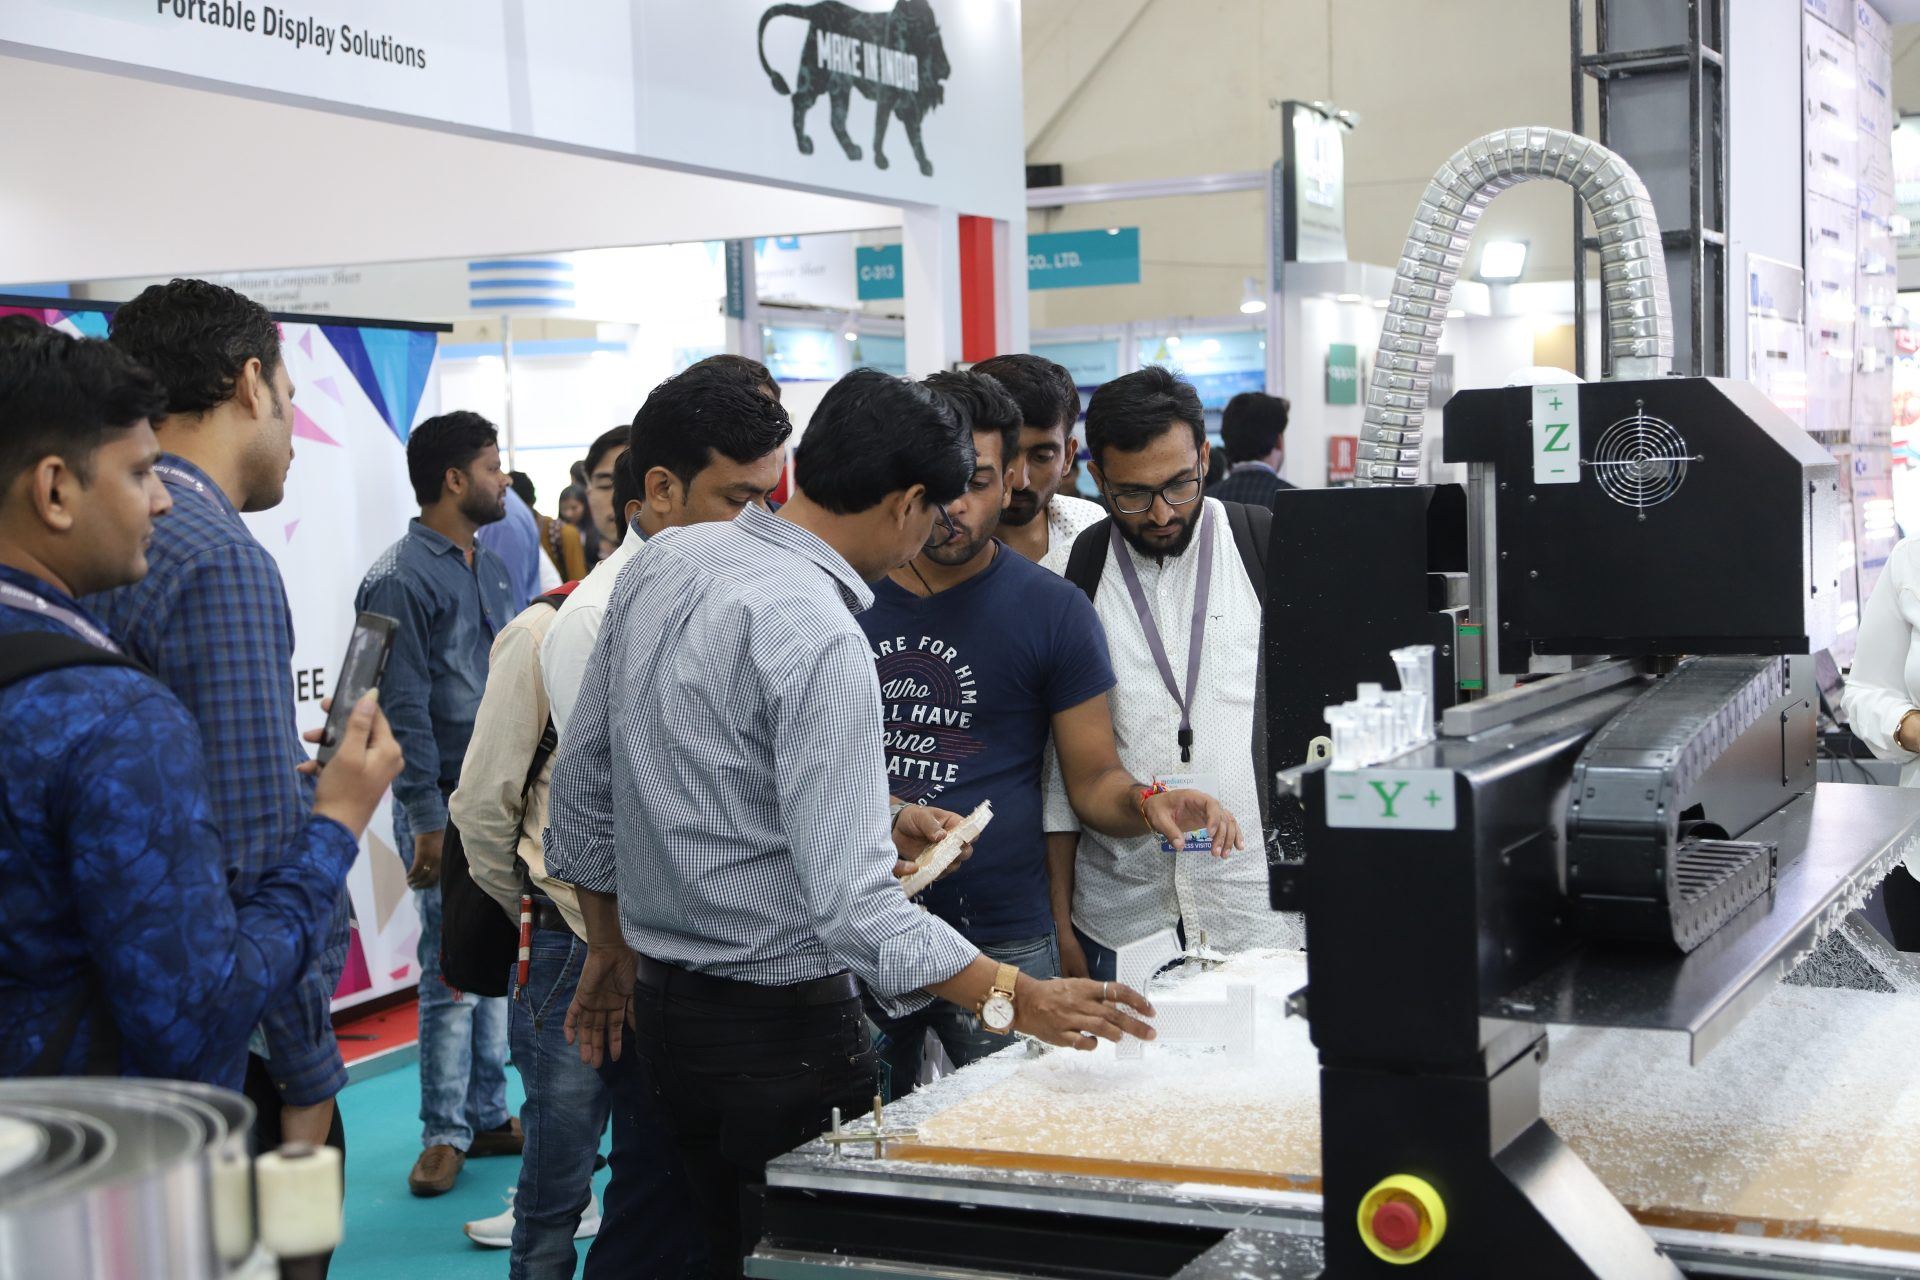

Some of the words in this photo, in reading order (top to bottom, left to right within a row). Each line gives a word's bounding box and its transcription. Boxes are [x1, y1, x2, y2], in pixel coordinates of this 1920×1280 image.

[263, 6, 335, 55] Display
[340, 24, 426, 69] Solutions
[816, 28, 862, 78] MAKE
[863, 41, 879, 83] IN
[880, 45, 919, 93] INDIA
[1054, 251, 1083, 268] LTD.
[1543, 423, 1570, 452] Z
[918, 635, 958, 664] FOR
[955, 664, 978, 705] HIM
[882, 677, 931, 699] Who
[910, 704, 973, 729] HAVE
[1368, 780, 1410, 818] Y
